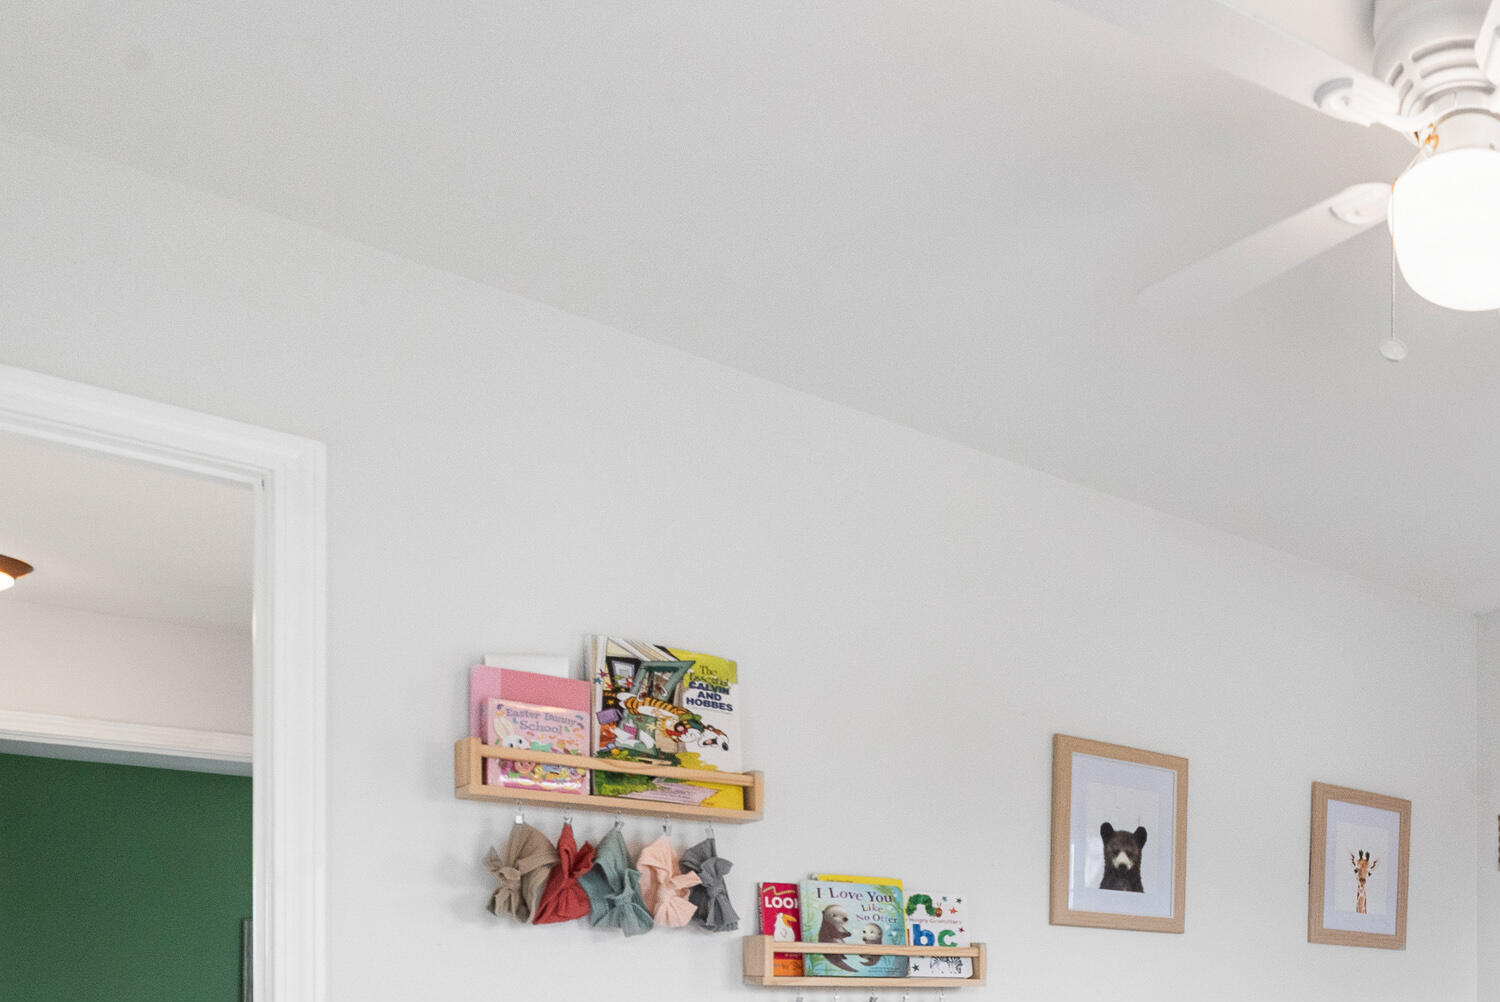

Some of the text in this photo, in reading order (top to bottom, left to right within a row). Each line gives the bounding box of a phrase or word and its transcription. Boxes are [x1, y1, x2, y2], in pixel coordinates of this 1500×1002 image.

[699, 664, 718, 675] The
[689, 681, 730, 695] CALVIN
[697, 691, 722, 701] AND
[686, 697, 733, 711] HOBBES
[506, 708, 577, 727] Easter Bunny
[520, 720, 562, 734] School
[816, 887, 893, 904] I Love You
[861, 904, 884, 913] Like
[856, 913, 871, 921] No
[872, 914, 898, 924] Otter
